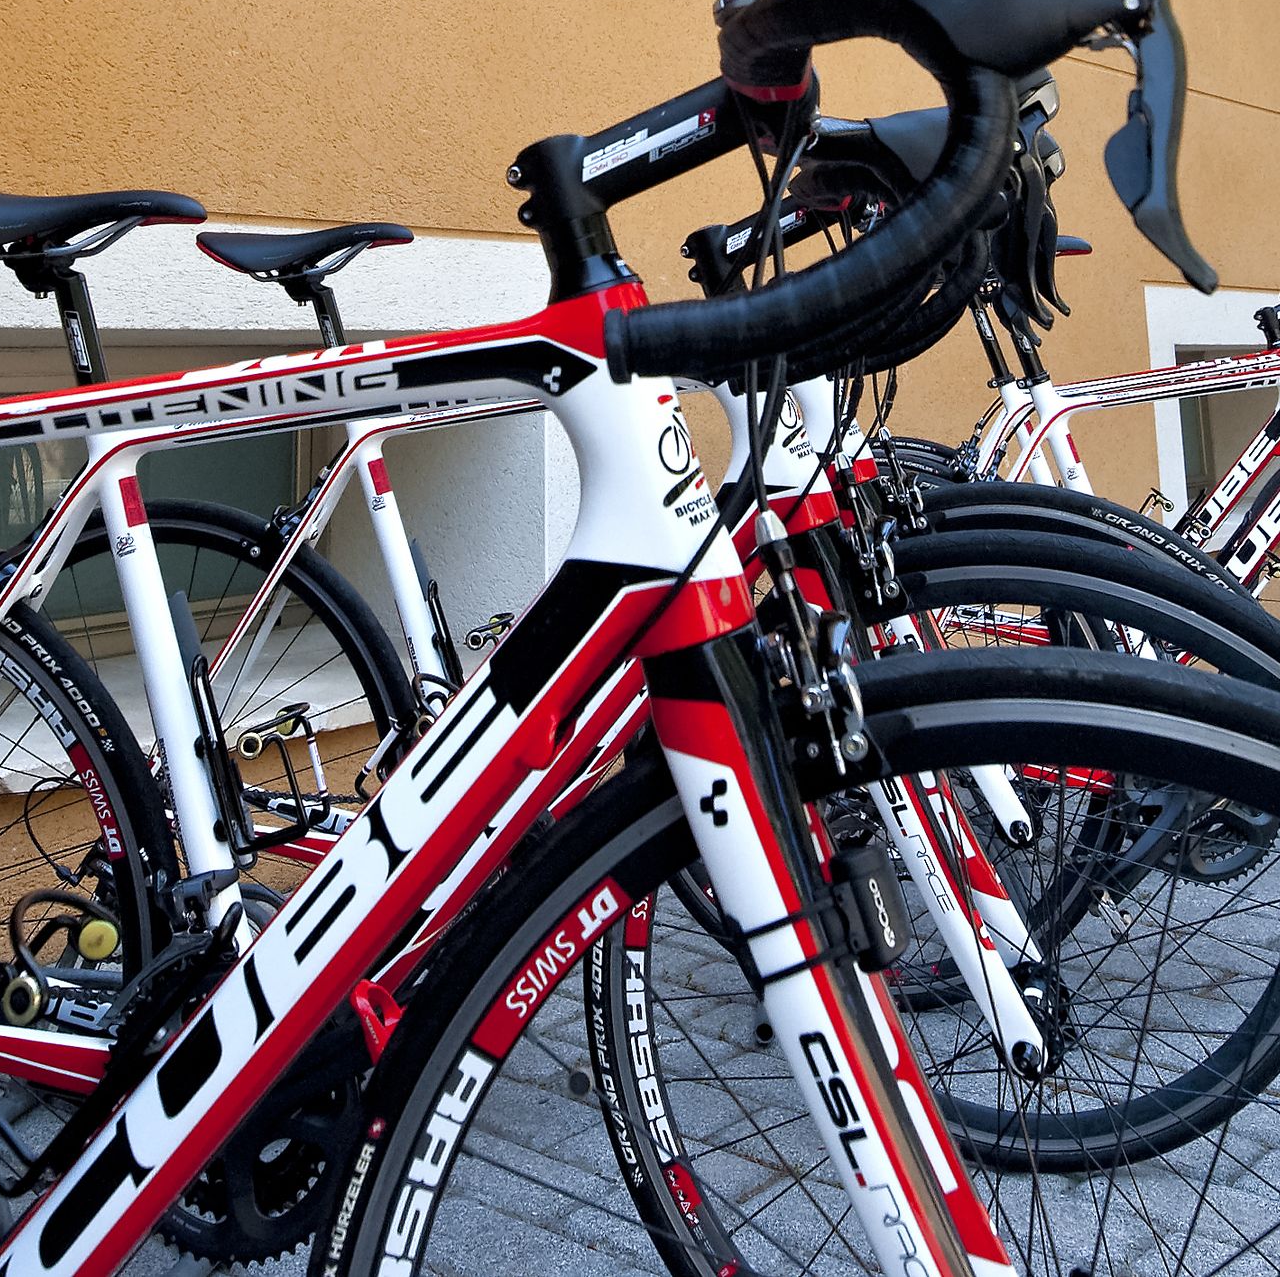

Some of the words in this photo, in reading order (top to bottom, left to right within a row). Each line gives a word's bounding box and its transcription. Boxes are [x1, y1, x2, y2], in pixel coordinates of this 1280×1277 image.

[688, 510, 710, 527] MAX
[1104, 512, 1167, 546] GRAND
[1164, 541, 1207, 573] PRIX
[20, 631, 63, 674] PRIX
[80, 768, 113, 821] SWISS
[101, 822, 123, 854] DT
[578, 885, 621, 941] DT
[504, 930, 577, 1020] SWISS
[591, 1002, 612, 1067] PRIX
[329, 1142, 375, 1259] HÜRZELER
